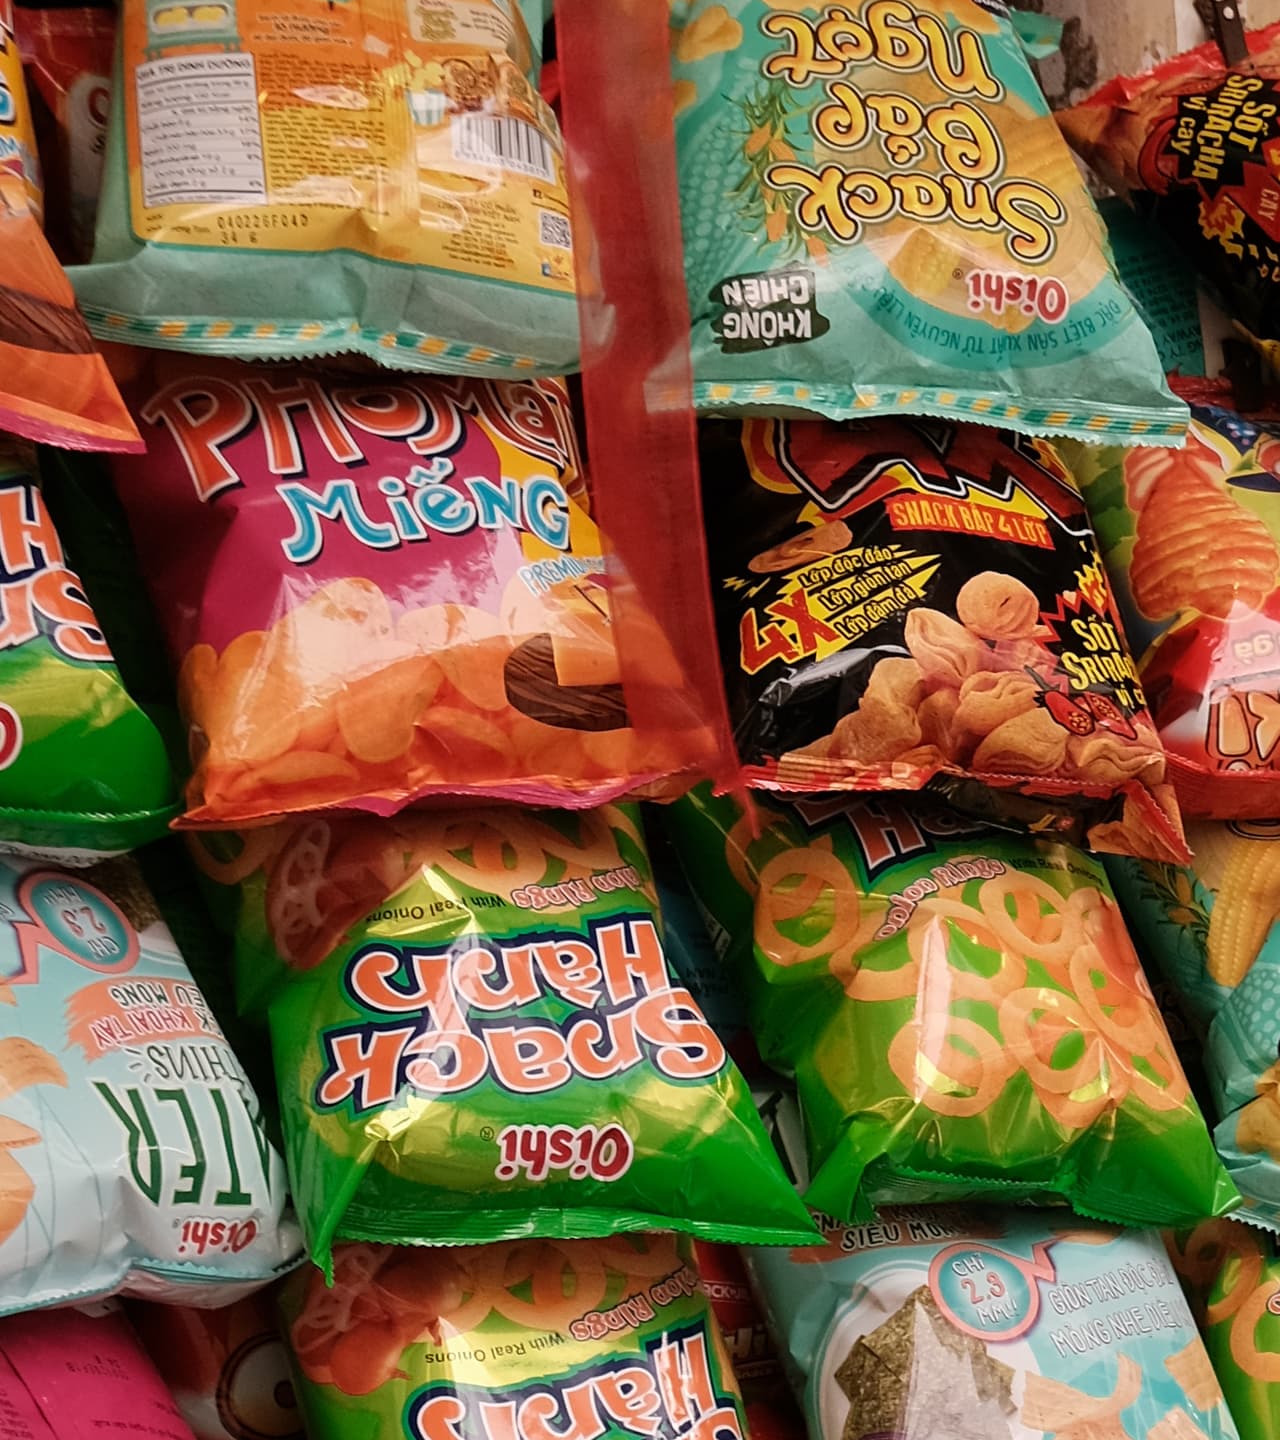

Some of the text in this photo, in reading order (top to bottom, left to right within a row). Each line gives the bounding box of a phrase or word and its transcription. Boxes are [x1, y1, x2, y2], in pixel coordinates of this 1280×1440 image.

[1171, 117, 1198, 156] cay
[1227, 101, 1277, 153] SỐT
[766, 162, 1064, 264] Snack
[1257, 187, 1280, 220] CAY
[722, 274, 810, 308] CHIÊN
[966, 269, 1070, 325] Oishi
[723, 310, 812, 344] KHÔNG
[893, 501, 1050, 546] SNACK BẮP 4 LỚP
[801, 565, 835, 589] Lớp
[834, 553, 866, 584] độc
[819, 587, 852, 612] Lớp
[853, 573, 885, 606] giòn
[836, 615, 868, 641] Lớp
[1071, 614, 1119, 650] SỐT
[1233, 632, 1276, 664] gà
[365, 894, 507, 924] With Onions
[128, 1006, 190, 1038] KHOAI
[319, 985, 725, 1112] Snack
[495, 1122, 633, 1182] Oishi
[178, 1214, 258, 1256] Oishi
[960, 1271, 1007, 1305] 2.3
[425, 1331, 565, 1366] With Real Onions
